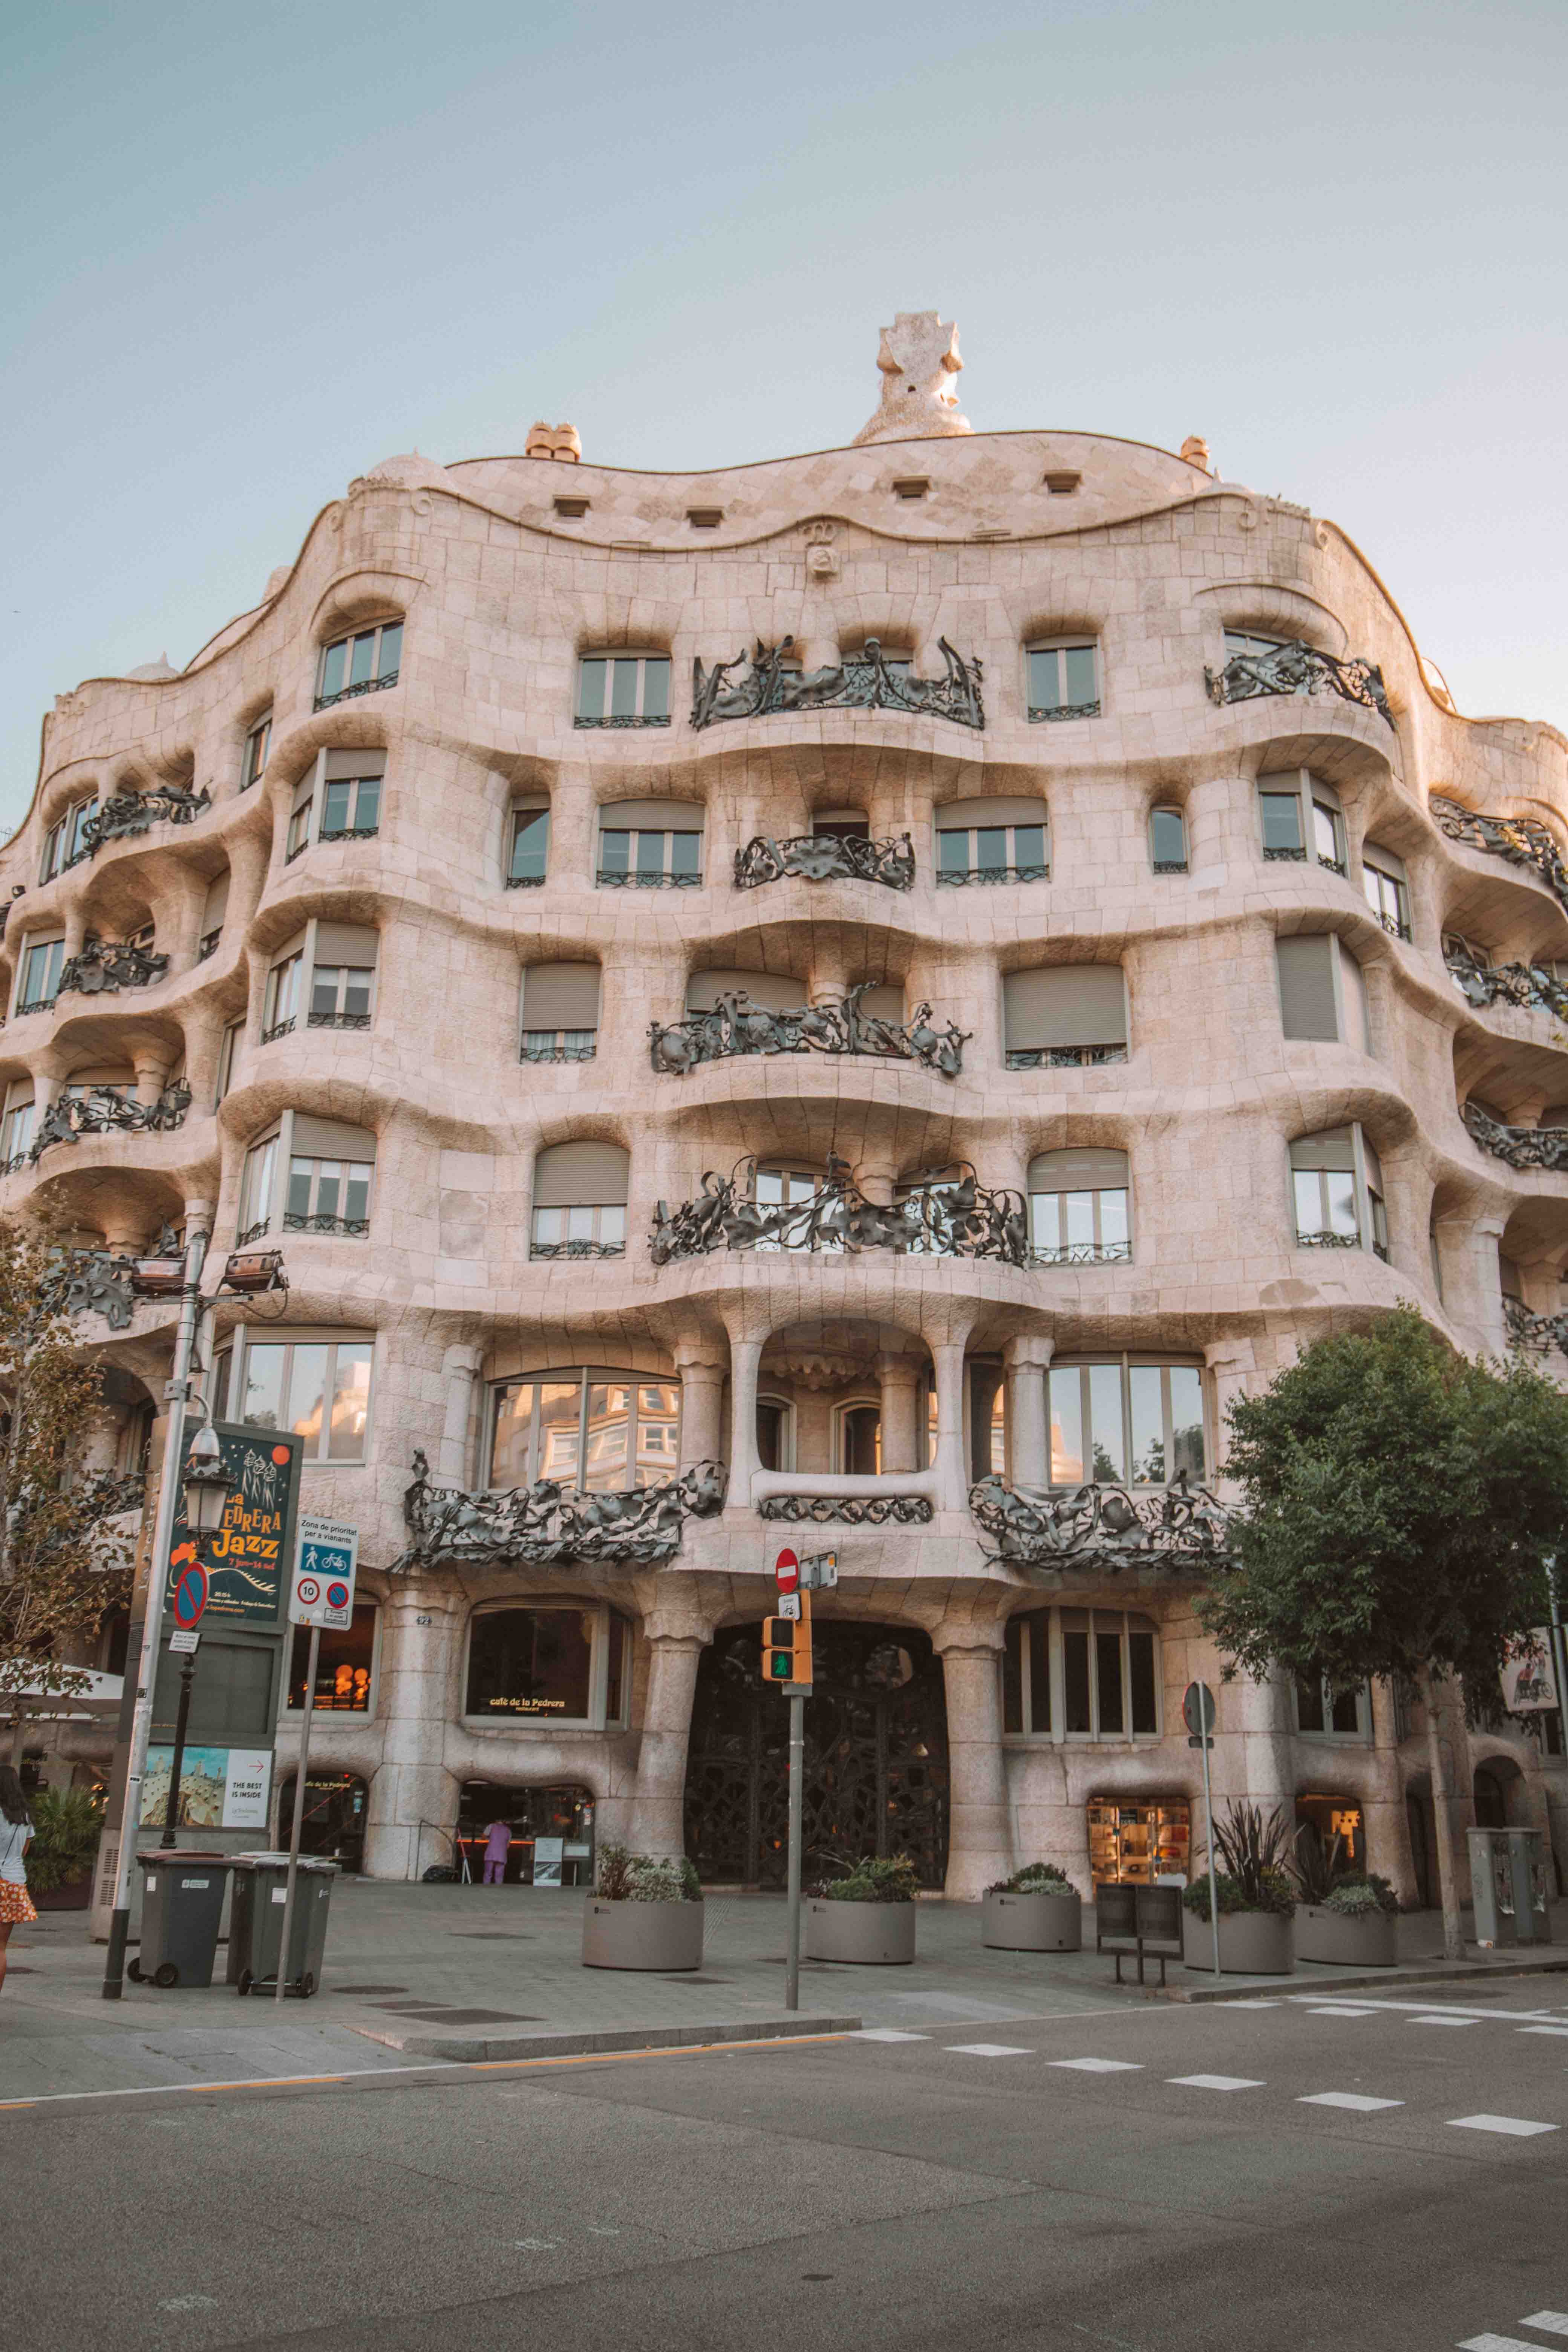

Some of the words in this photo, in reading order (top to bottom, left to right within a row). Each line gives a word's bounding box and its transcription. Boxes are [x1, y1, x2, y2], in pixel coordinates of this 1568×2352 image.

[223, 1505, 281, 1533] EDRERA
[302, 1519, 318, 1528] Zona
[330, 1526, 357, 1536] prioritat
[211, 1529, 280, 1559] Jazz
[324, 1533, 352, 1544] vianants
[303, 1586, 314, 1595] 10
[532, 1698, 565, 1707] Pedrera
